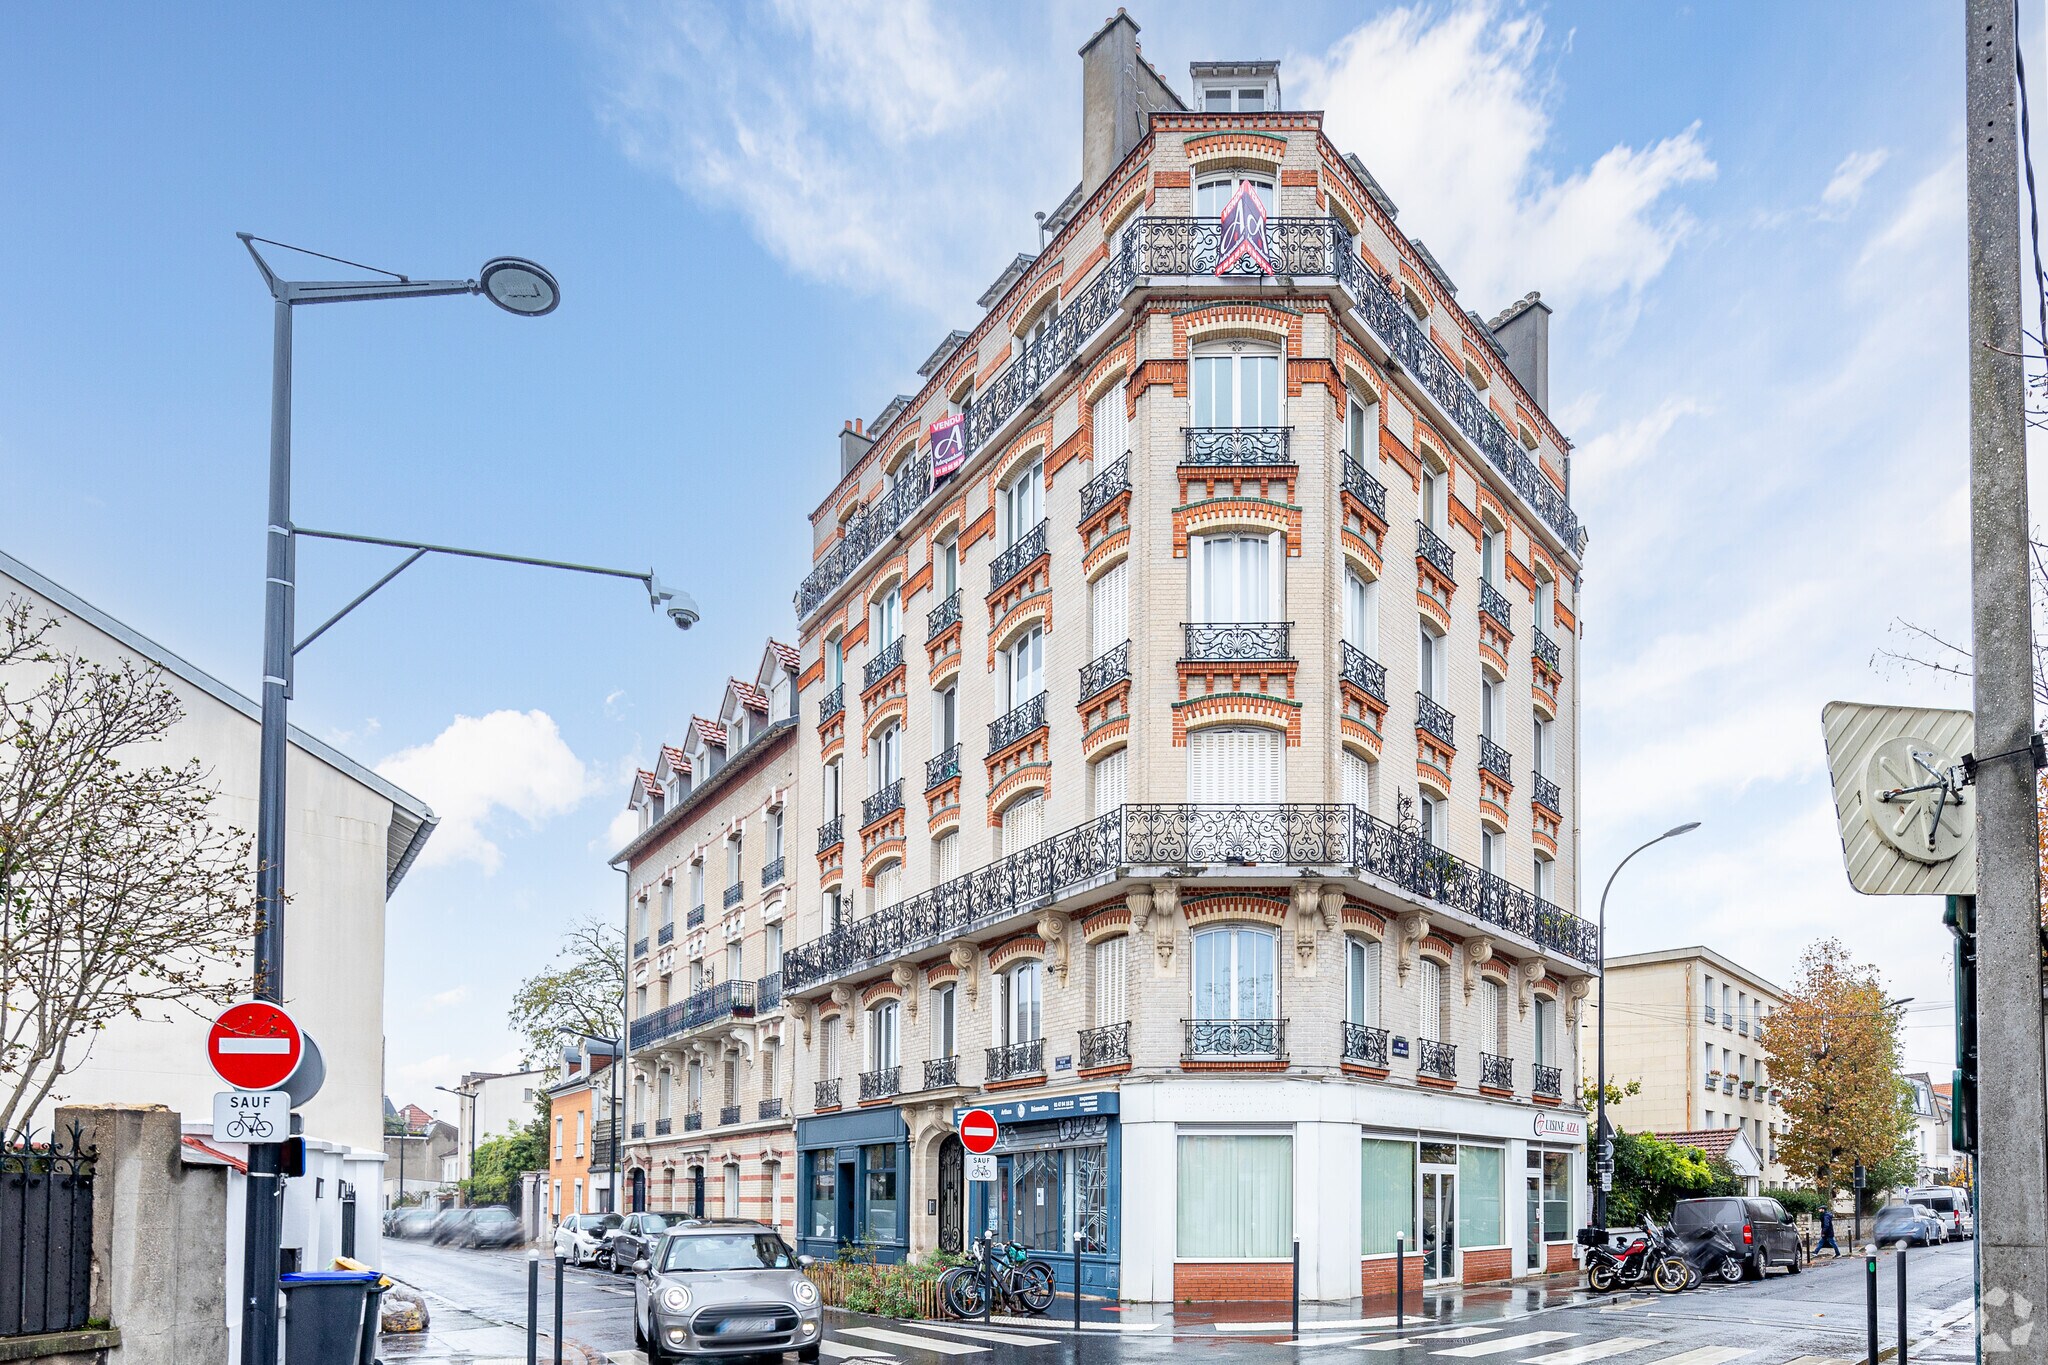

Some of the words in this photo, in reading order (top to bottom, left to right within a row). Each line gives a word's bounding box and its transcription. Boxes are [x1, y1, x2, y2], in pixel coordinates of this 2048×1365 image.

[933, 414, 961, 431] VENDU
[230, 1096, 271, 1108] SAUF
[1566, 1122, 1579, 1133] AZZA
